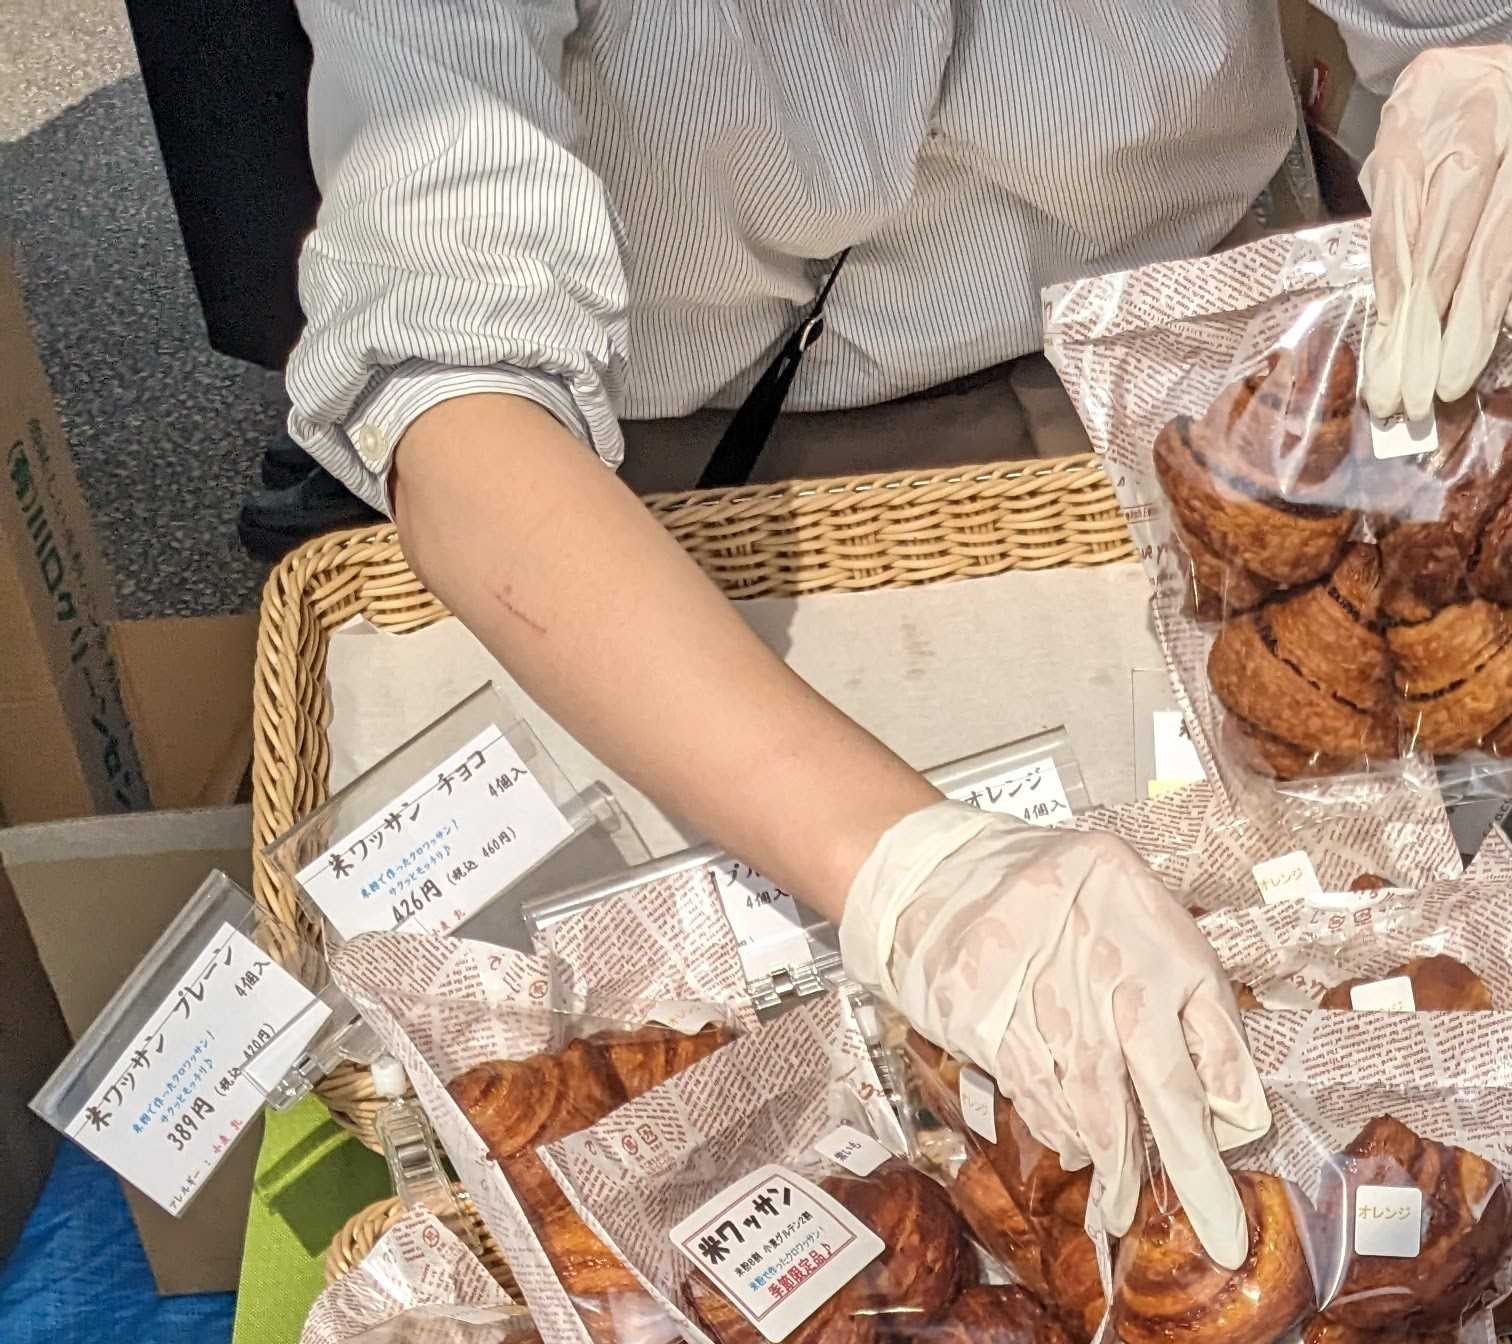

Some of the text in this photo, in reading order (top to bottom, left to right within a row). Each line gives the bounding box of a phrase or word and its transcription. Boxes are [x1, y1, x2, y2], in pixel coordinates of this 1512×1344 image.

[437, 750, 487, 796] チョコ
[488, 767, 528, 798] 4個入
[1024, 799, 1067, 820] 4個入
[393, 880, 443, 923] 426円
[174, 946, 232, 1019] プレーン
[235, 961, 271, 997] 4個入
[167, 1097, 216, 1151] 389円
[699, 1186, 791, 1265] 米ワッサン
[1359, 1205, 1410, 1220] オレンジ
